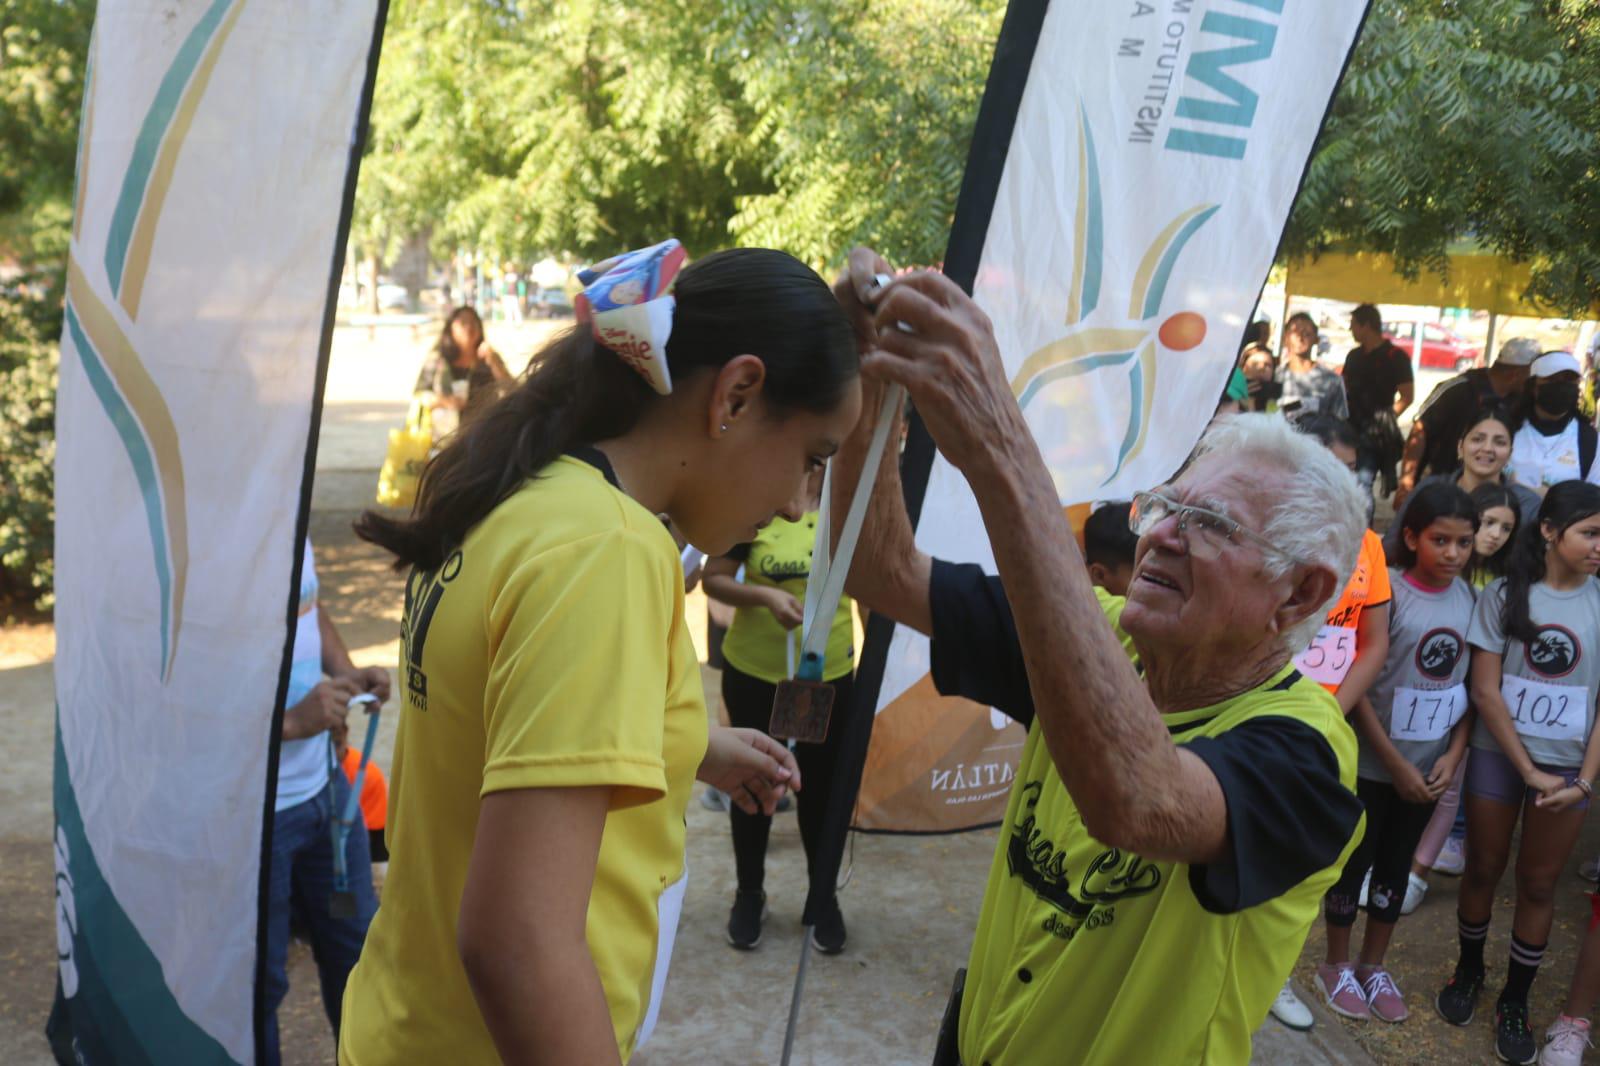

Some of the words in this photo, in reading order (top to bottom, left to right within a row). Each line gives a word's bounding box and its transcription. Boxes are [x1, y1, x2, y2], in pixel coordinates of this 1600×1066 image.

[759, 554, 806, 574] Casas
[1302, 635, 1349, 671] 55
[1400, 694, 1457, 734] 171
[1510, 686, 1569, 729] 102
